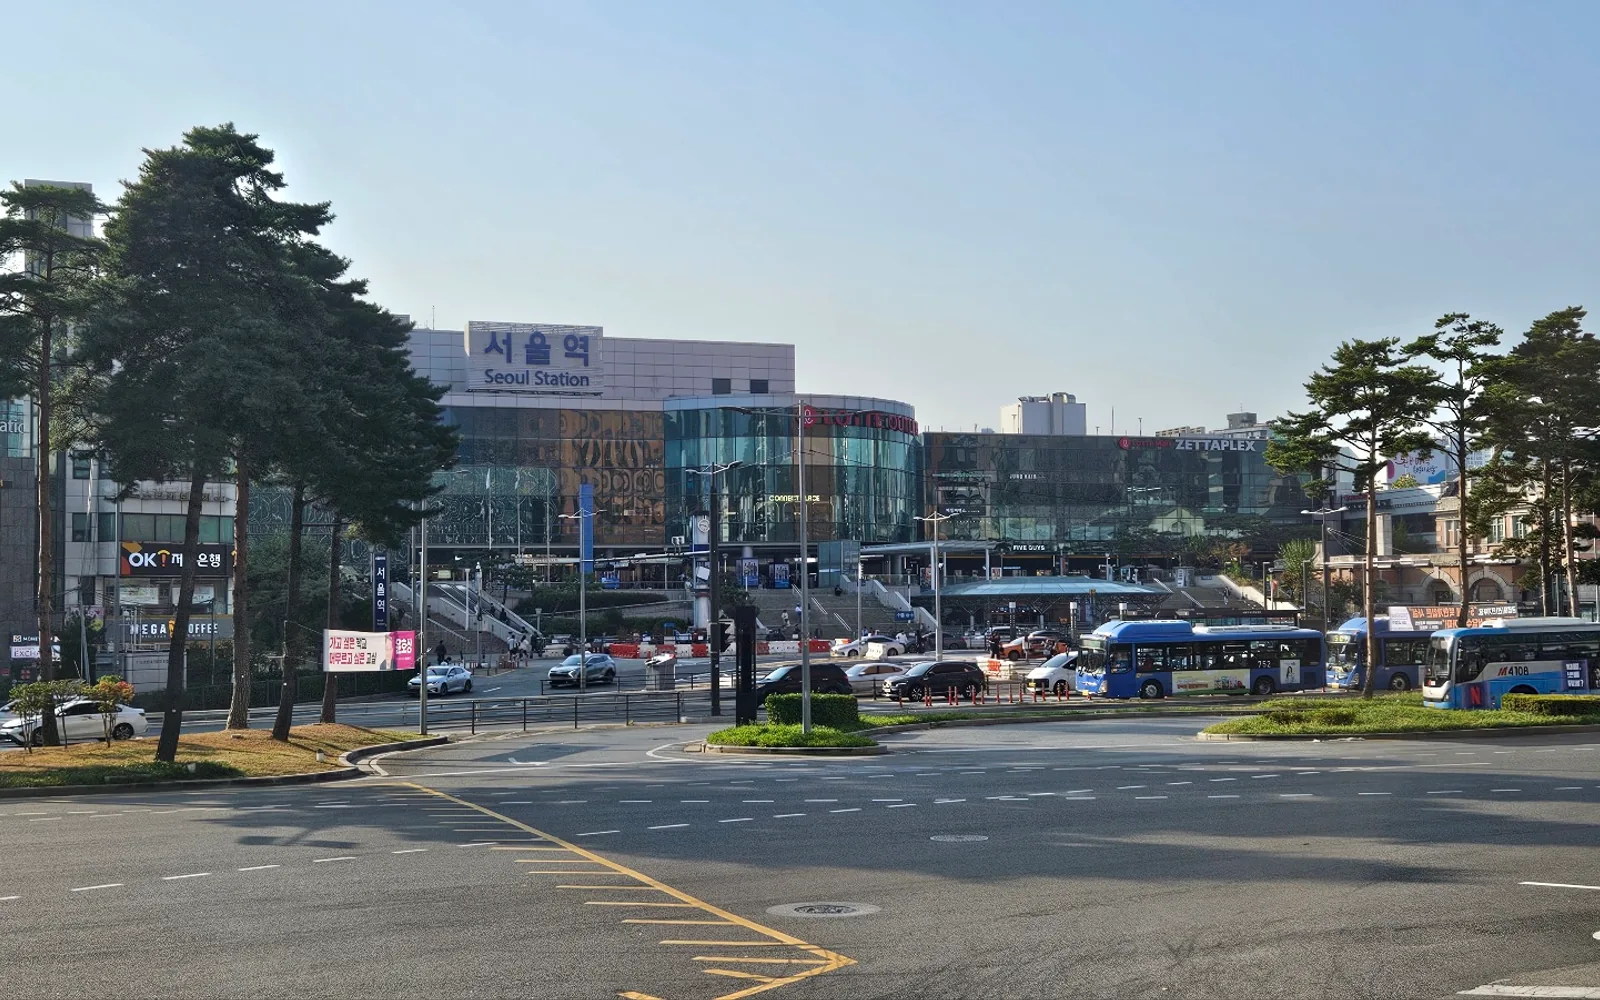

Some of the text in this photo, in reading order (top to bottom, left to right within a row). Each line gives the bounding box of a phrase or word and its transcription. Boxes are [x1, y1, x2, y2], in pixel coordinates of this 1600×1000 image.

[484, 331, 589, 367] 서울역
[484, 369, 590, 387] Seoul Station
[1175, 439, 1256, 452] ZETTAPLEX
[128, 552, 221, 568] OK 저은행
[376, 567, 385, 613] 서울역
[130, 623, 218, 635] MEGA OFFEE
[1257, 660, 1271, 668] 752
